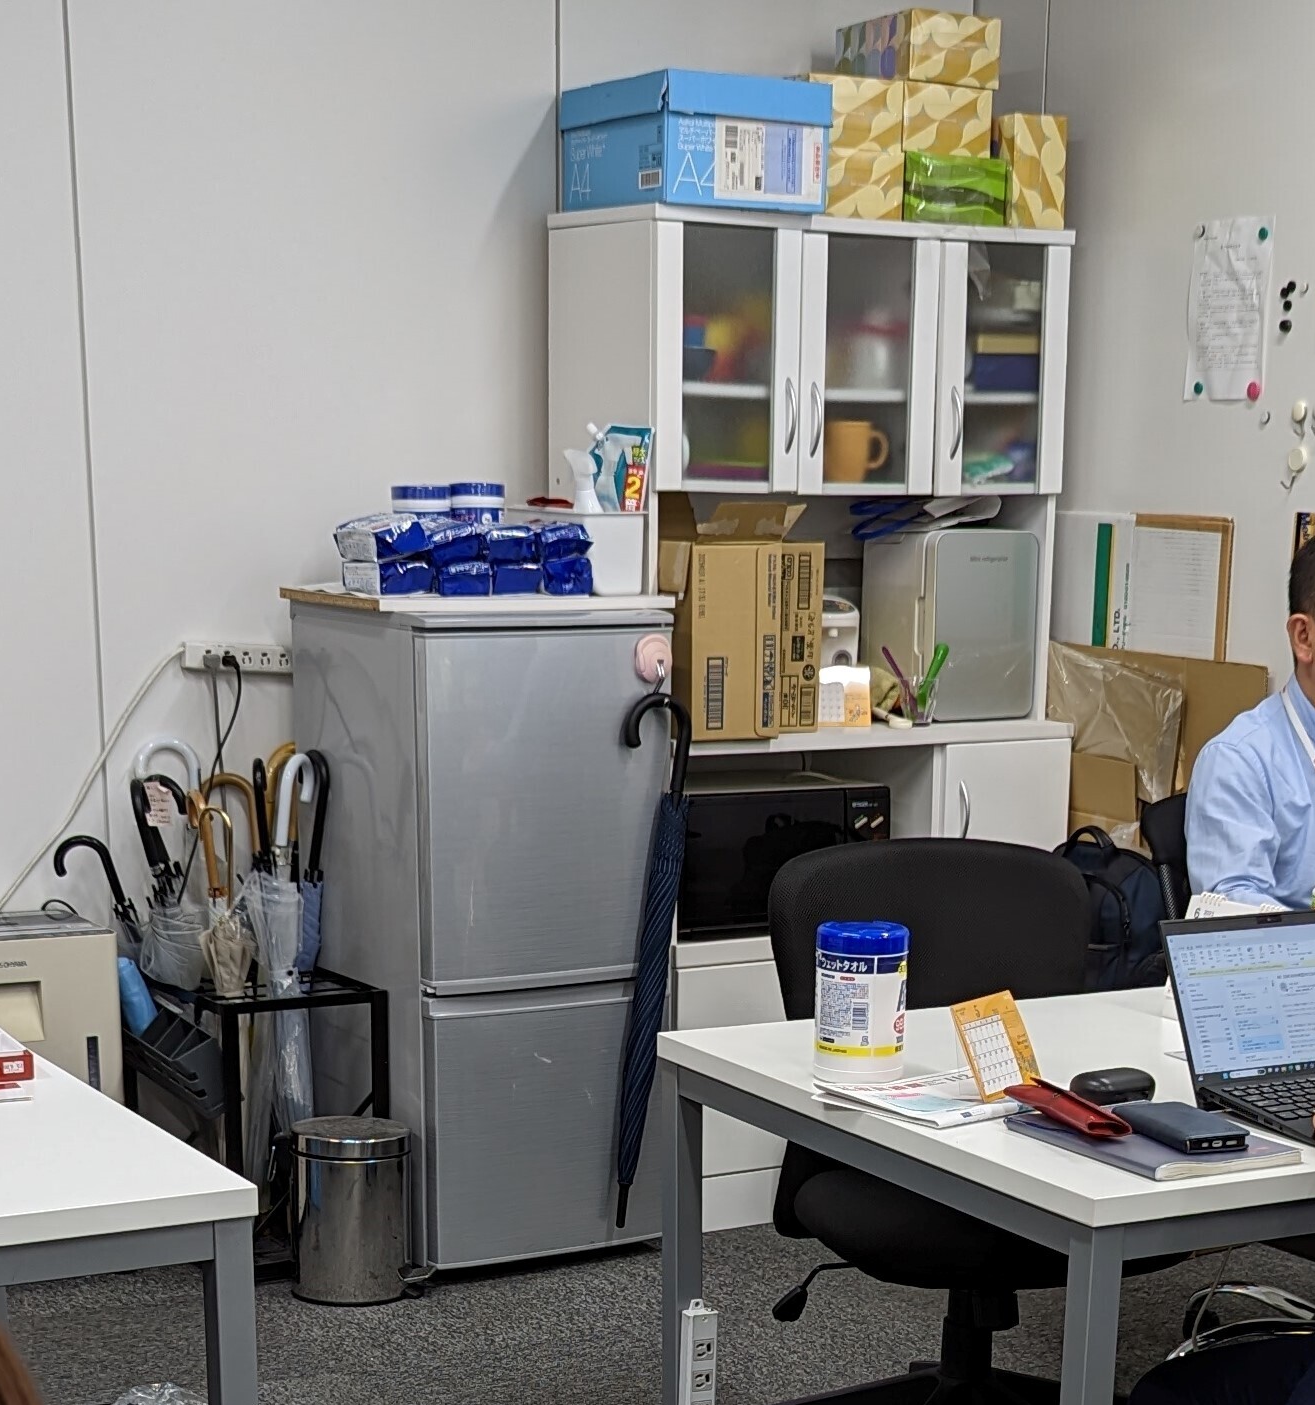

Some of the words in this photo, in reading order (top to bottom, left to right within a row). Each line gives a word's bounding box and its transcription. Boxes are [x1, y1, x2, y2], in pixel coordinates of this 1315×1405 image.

[569, 163, 592, 203] A4
[625, 476, 641, 500] 2
[1113, 608, 1121, 634] LTD.
[1193, 907, 1201, 919] 6
[821, 958, 868, 973] ウェットタオル
[974, 1004, 981, 1018] 5
